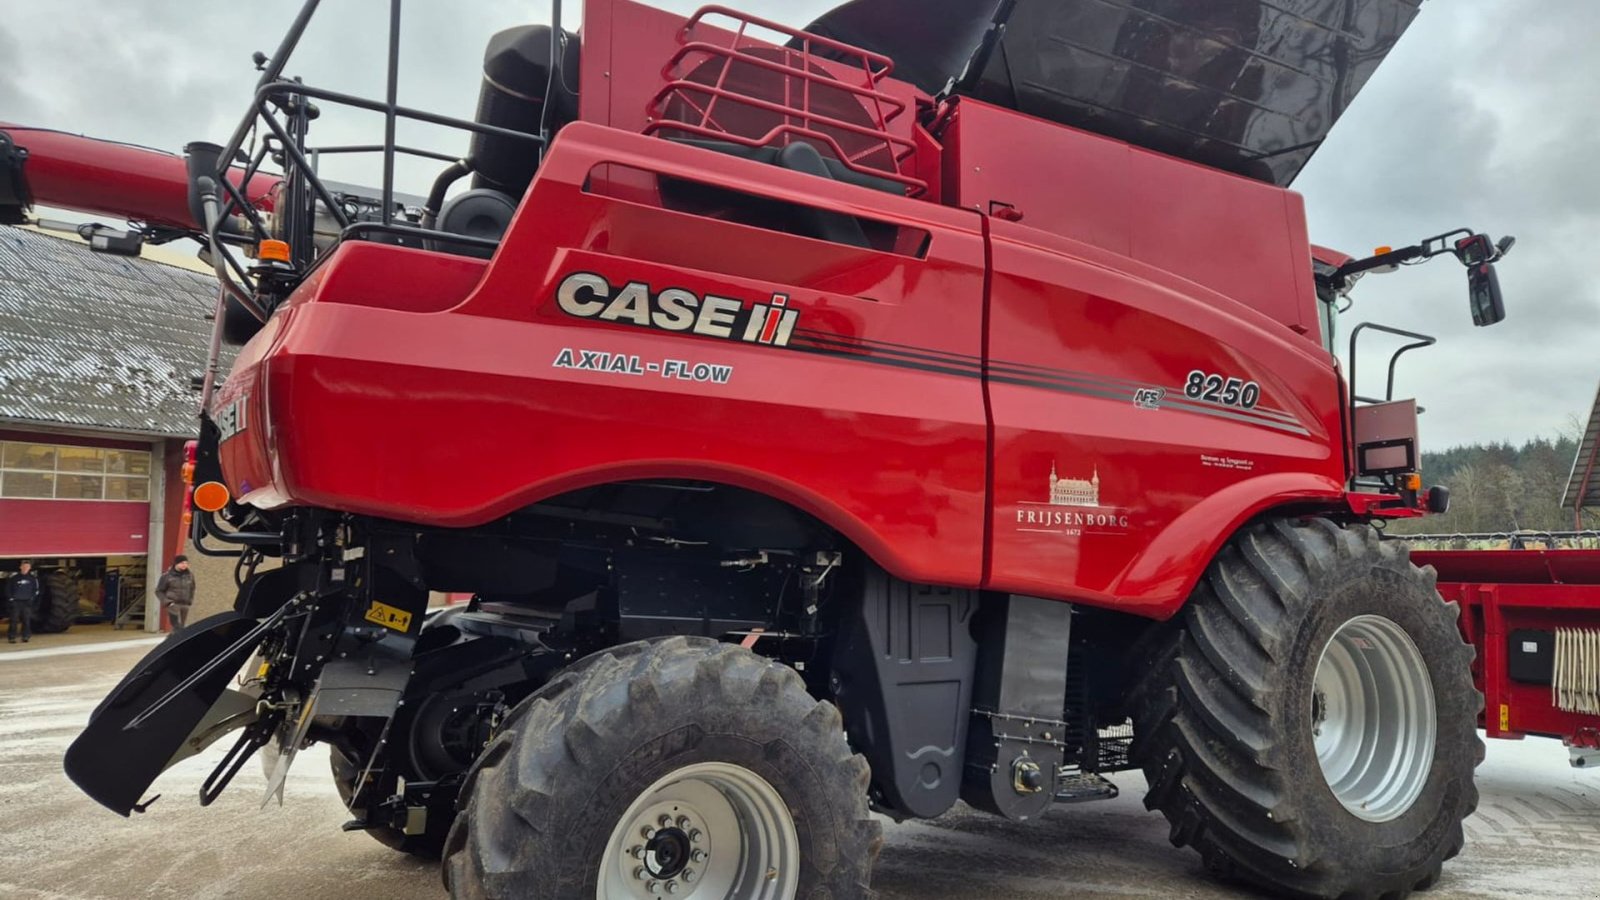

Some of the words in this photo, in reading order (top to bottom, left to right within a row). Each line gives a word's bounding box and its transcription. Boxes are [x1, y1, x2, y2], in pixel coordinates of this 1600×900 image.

[557, 272, 742, 338] CASE
[1184, 370, 1259, 409] 8250
[1017, 510, 1128, 527] FRIJSENBORG
